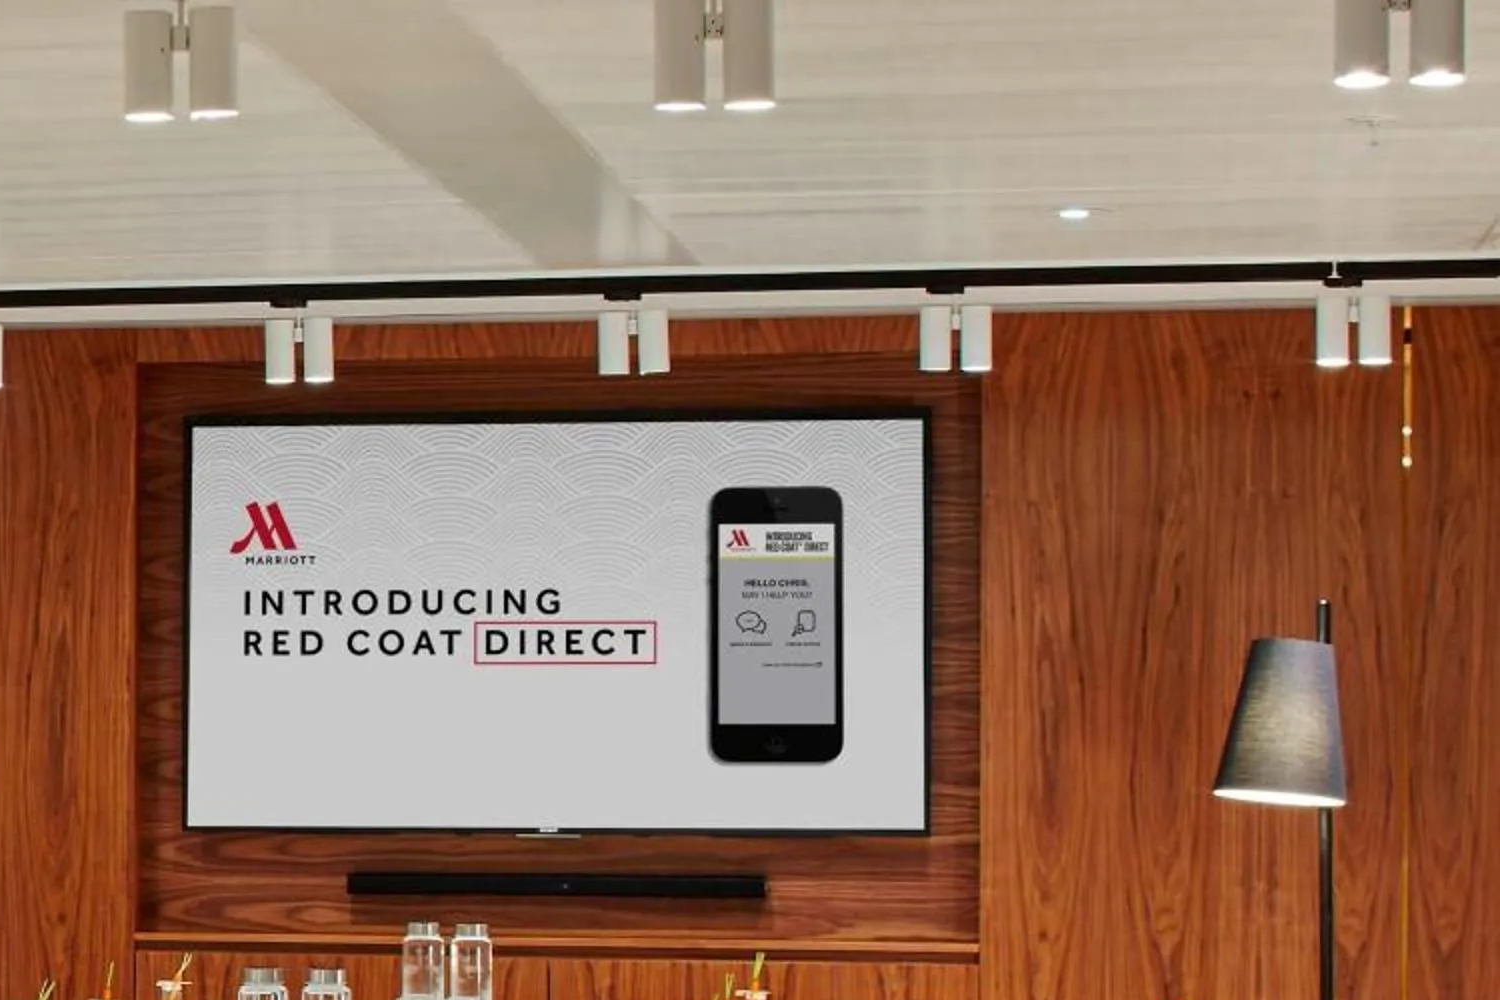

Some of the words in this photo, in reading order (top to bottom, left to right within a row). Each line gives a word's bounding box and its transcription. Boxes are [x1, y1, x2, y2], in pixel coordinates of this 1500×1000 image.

[245, 555, 316, 565] MARRIOTT
[743, 579, 776, 588] HELLO
[244, 588, 562, 616] INTRODUCING
[243, 629, 324, 657] RED
[346, 629, 463, 657] COAT
[485, 628, 647, 656] DIRECT
